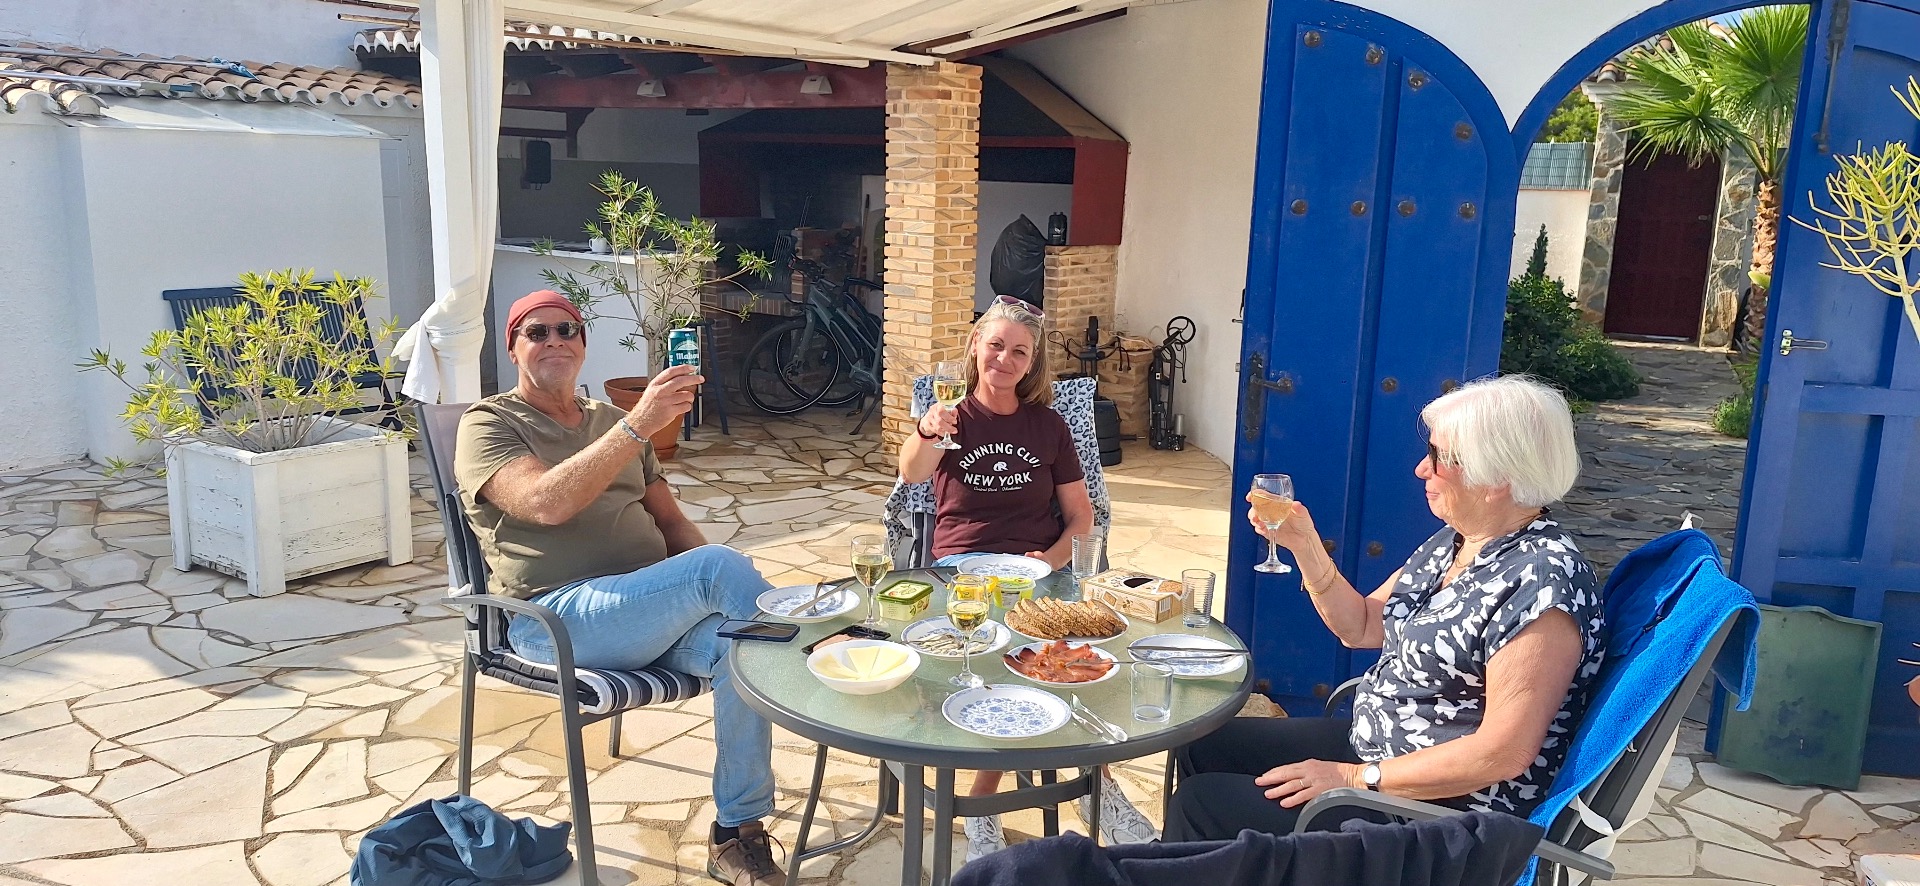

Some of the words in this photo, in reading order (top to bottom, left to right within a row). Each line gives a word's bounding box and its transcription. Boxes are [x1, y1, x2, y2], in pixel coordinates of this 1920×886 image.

[958, 442, 1014, 471] RUNNING
[1016, 447, 1042, 468] CLU
[963, 472, 995, 487] NEW
[998, 471, 1033, 487] YORK
